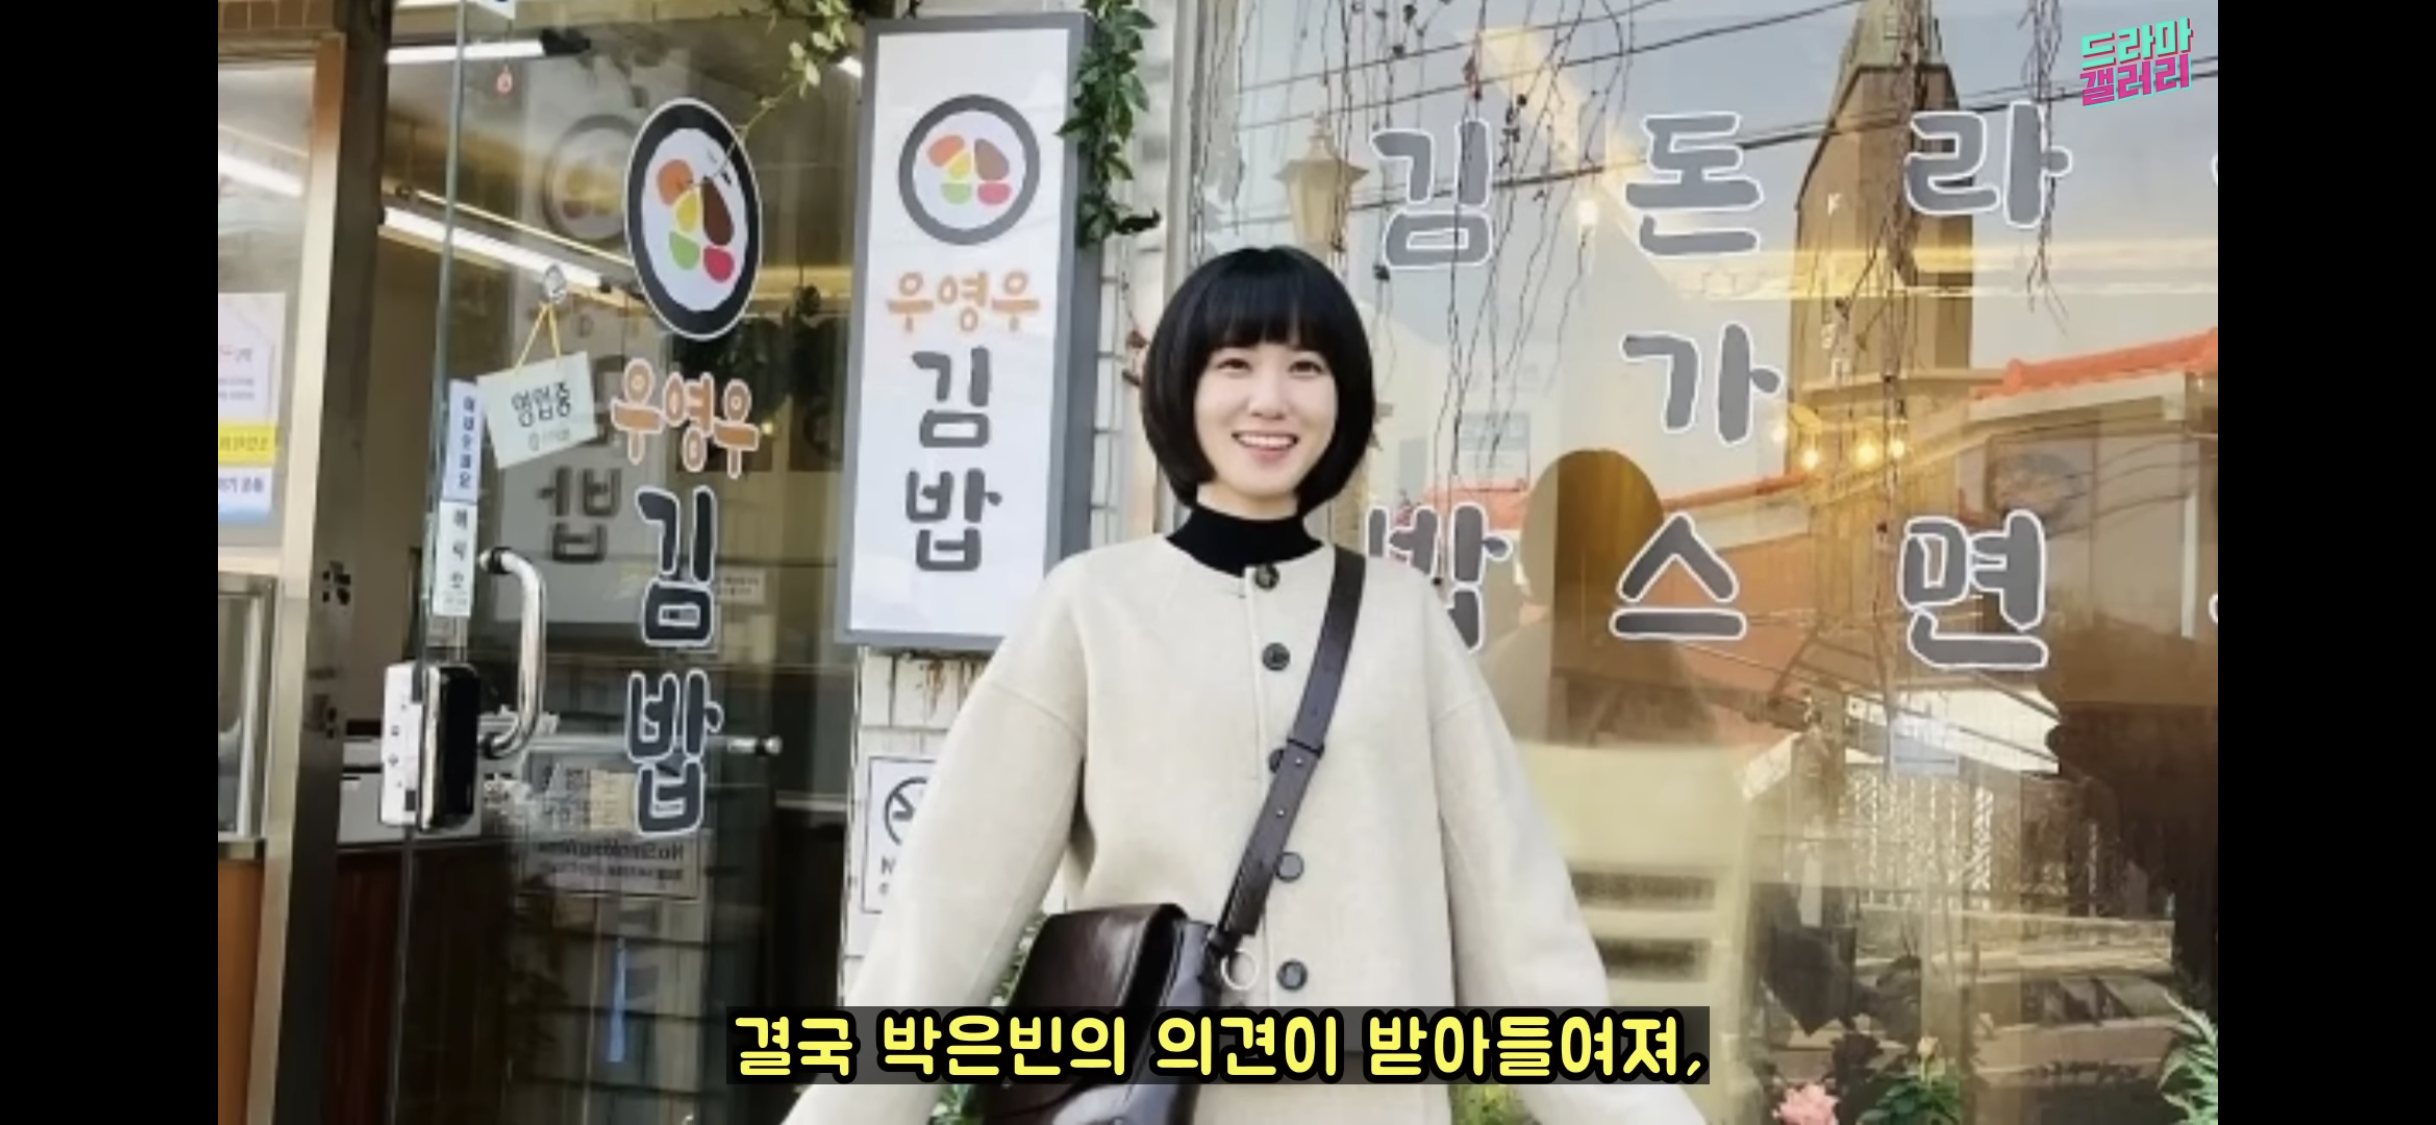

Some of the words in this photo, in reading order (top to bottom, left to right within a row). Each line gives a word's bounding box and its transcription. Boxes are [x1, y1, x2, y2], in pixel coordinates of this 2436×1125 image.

[510, 380, 571, 428] 영업중
[887, 270, 1041, 333] 우영우
[1611, 112, 1782, 639] 돈가스
[1900, 101, 2073, 669] 라면
[611, 357, 759, 479] 우영우
[905, 345, 1003, 572] 김밥
[624, 484, 724, 835] 김밥
